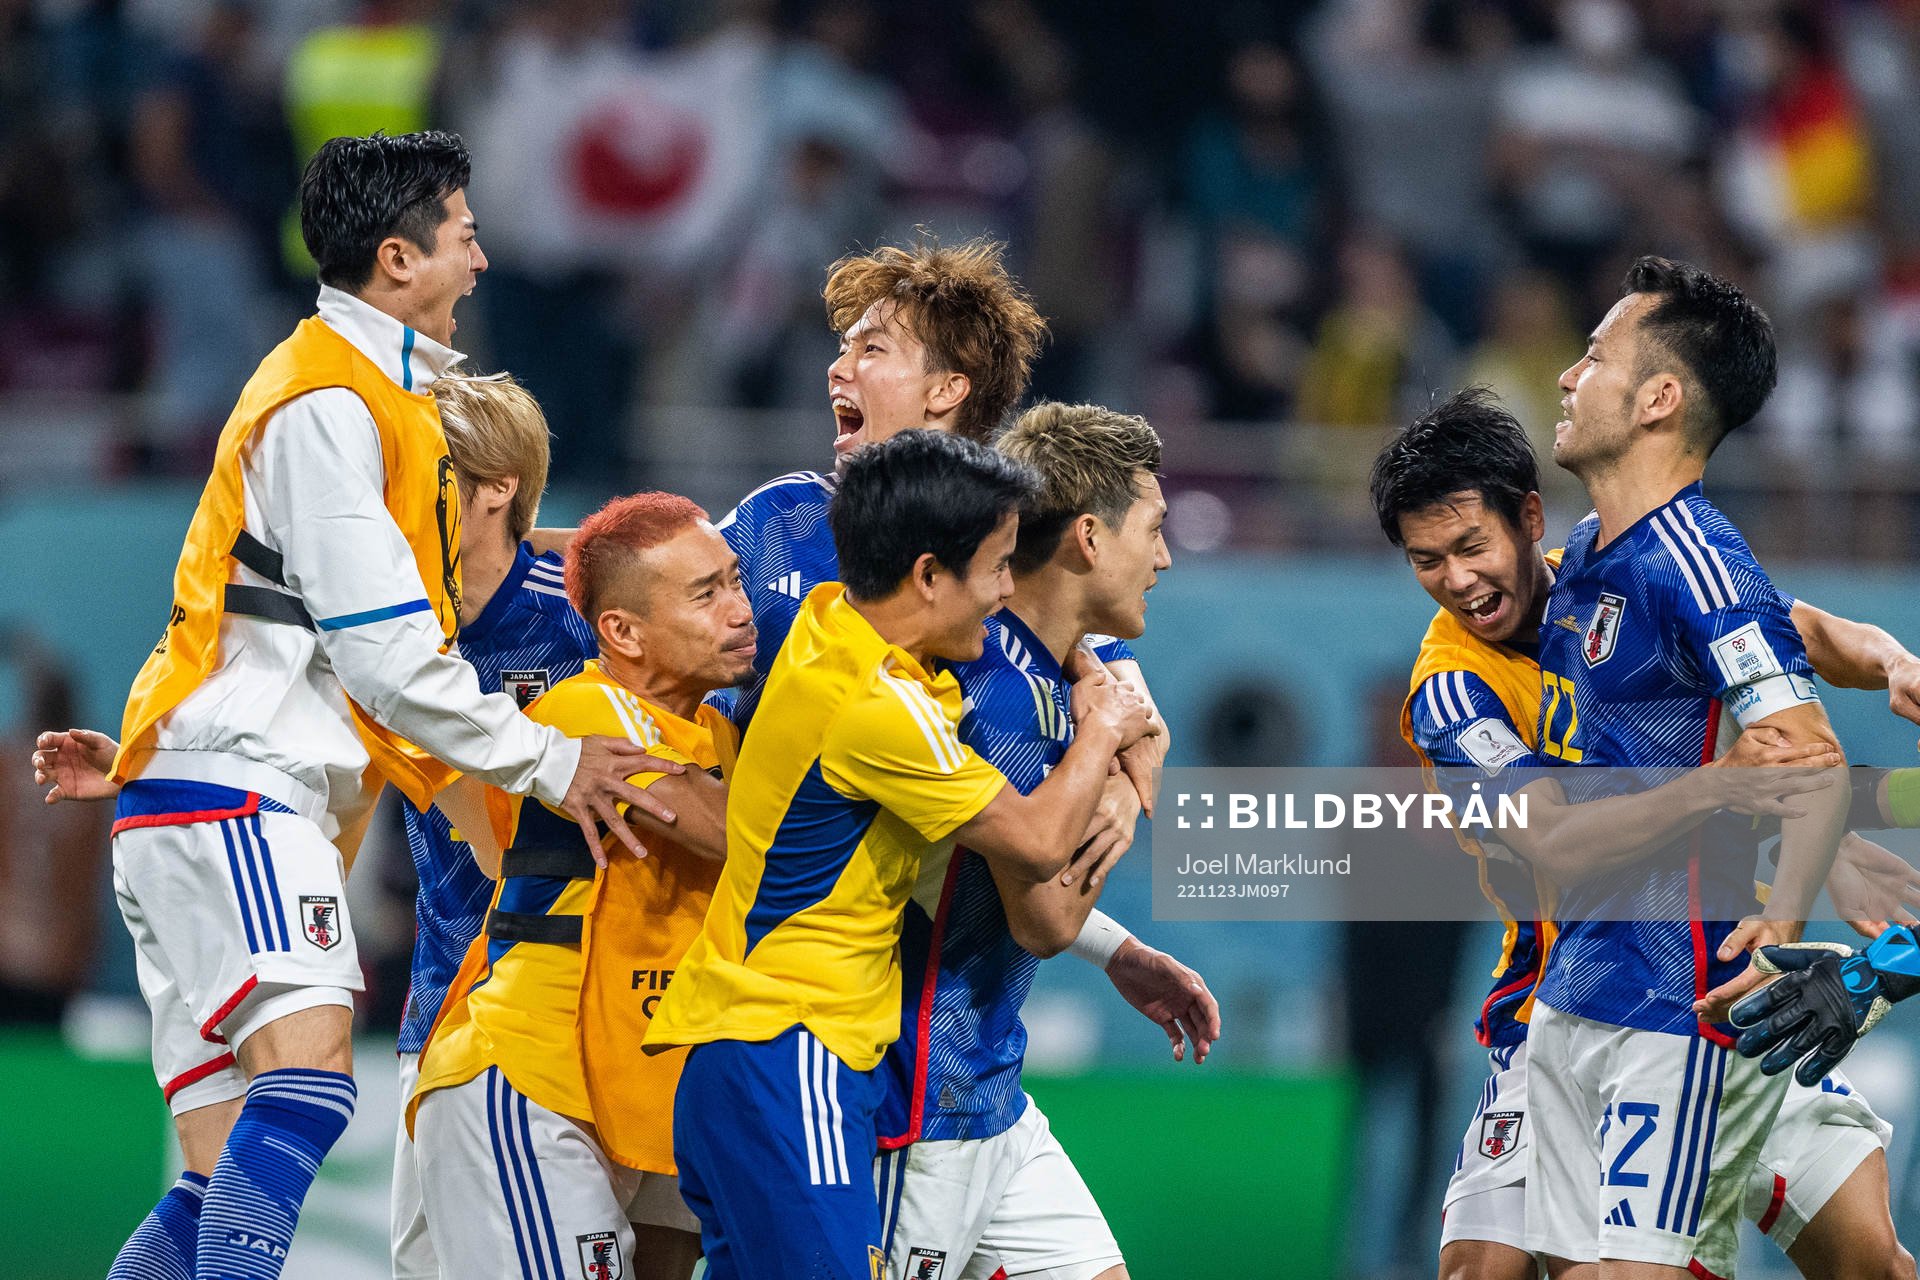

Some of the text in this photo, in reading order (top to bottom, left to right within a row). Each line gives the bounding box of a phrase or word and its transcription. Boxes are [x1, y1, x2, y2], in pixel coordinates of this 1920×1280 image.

[1738, 655, 1760, 670] UNITES
[1542, 669, 1583, 764] 22
[632, 969, 675, 990] FIF
[586, 1232, 609, 1241] JAPAN
[918, 1249, 940, 1257] JAPAN
